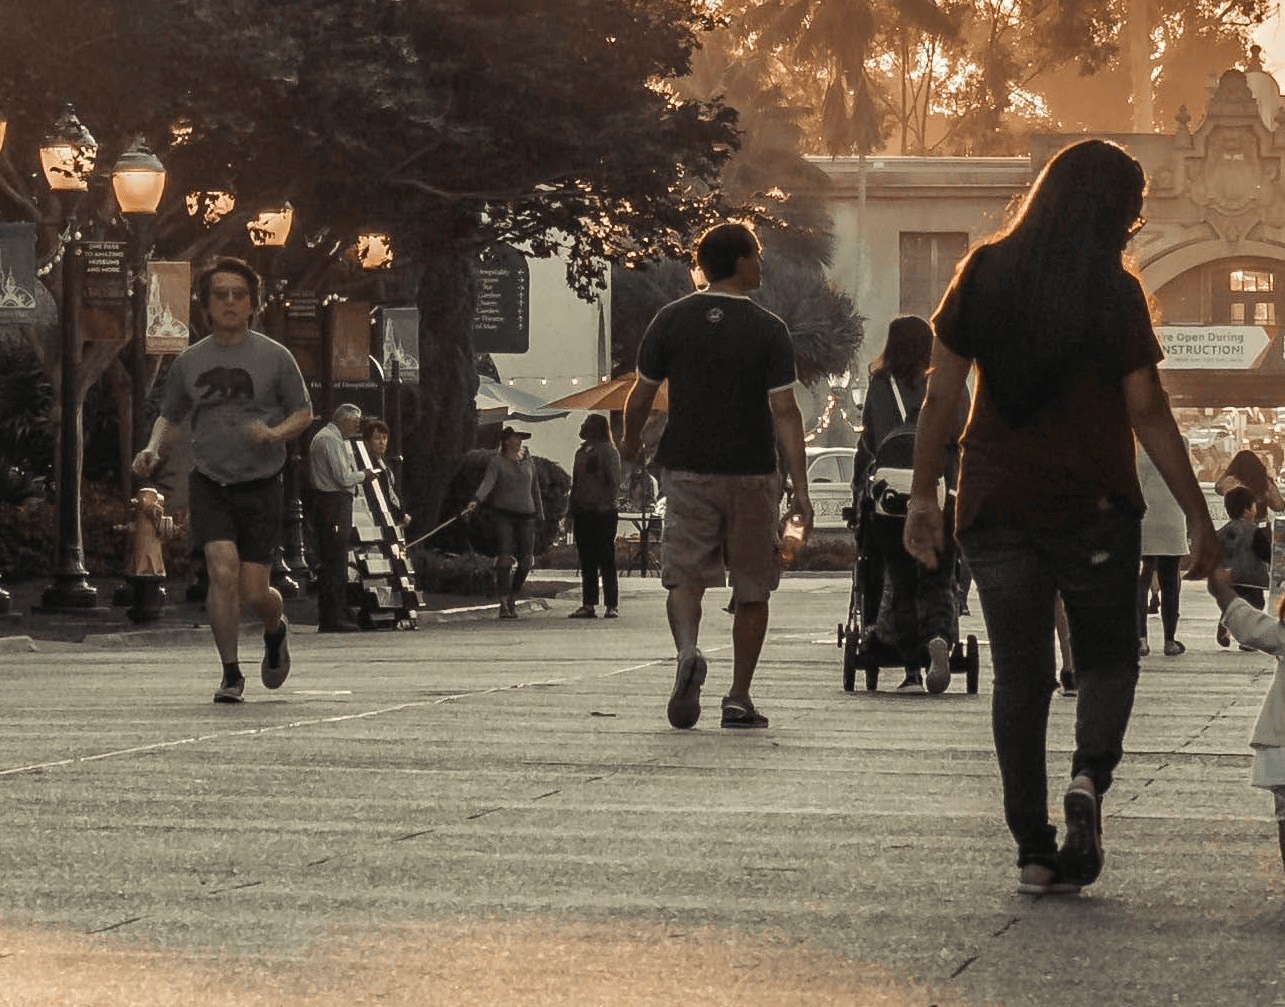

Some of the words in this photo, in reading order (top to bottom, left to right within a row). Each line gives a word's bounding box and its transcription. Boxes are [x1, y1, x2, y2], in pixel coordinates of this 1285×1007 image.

[1176, 333, 1205, 343] Open
[1208, 332, 1244, 344] During
[1164, 345, 1244, 355] NSTRUCTION!
